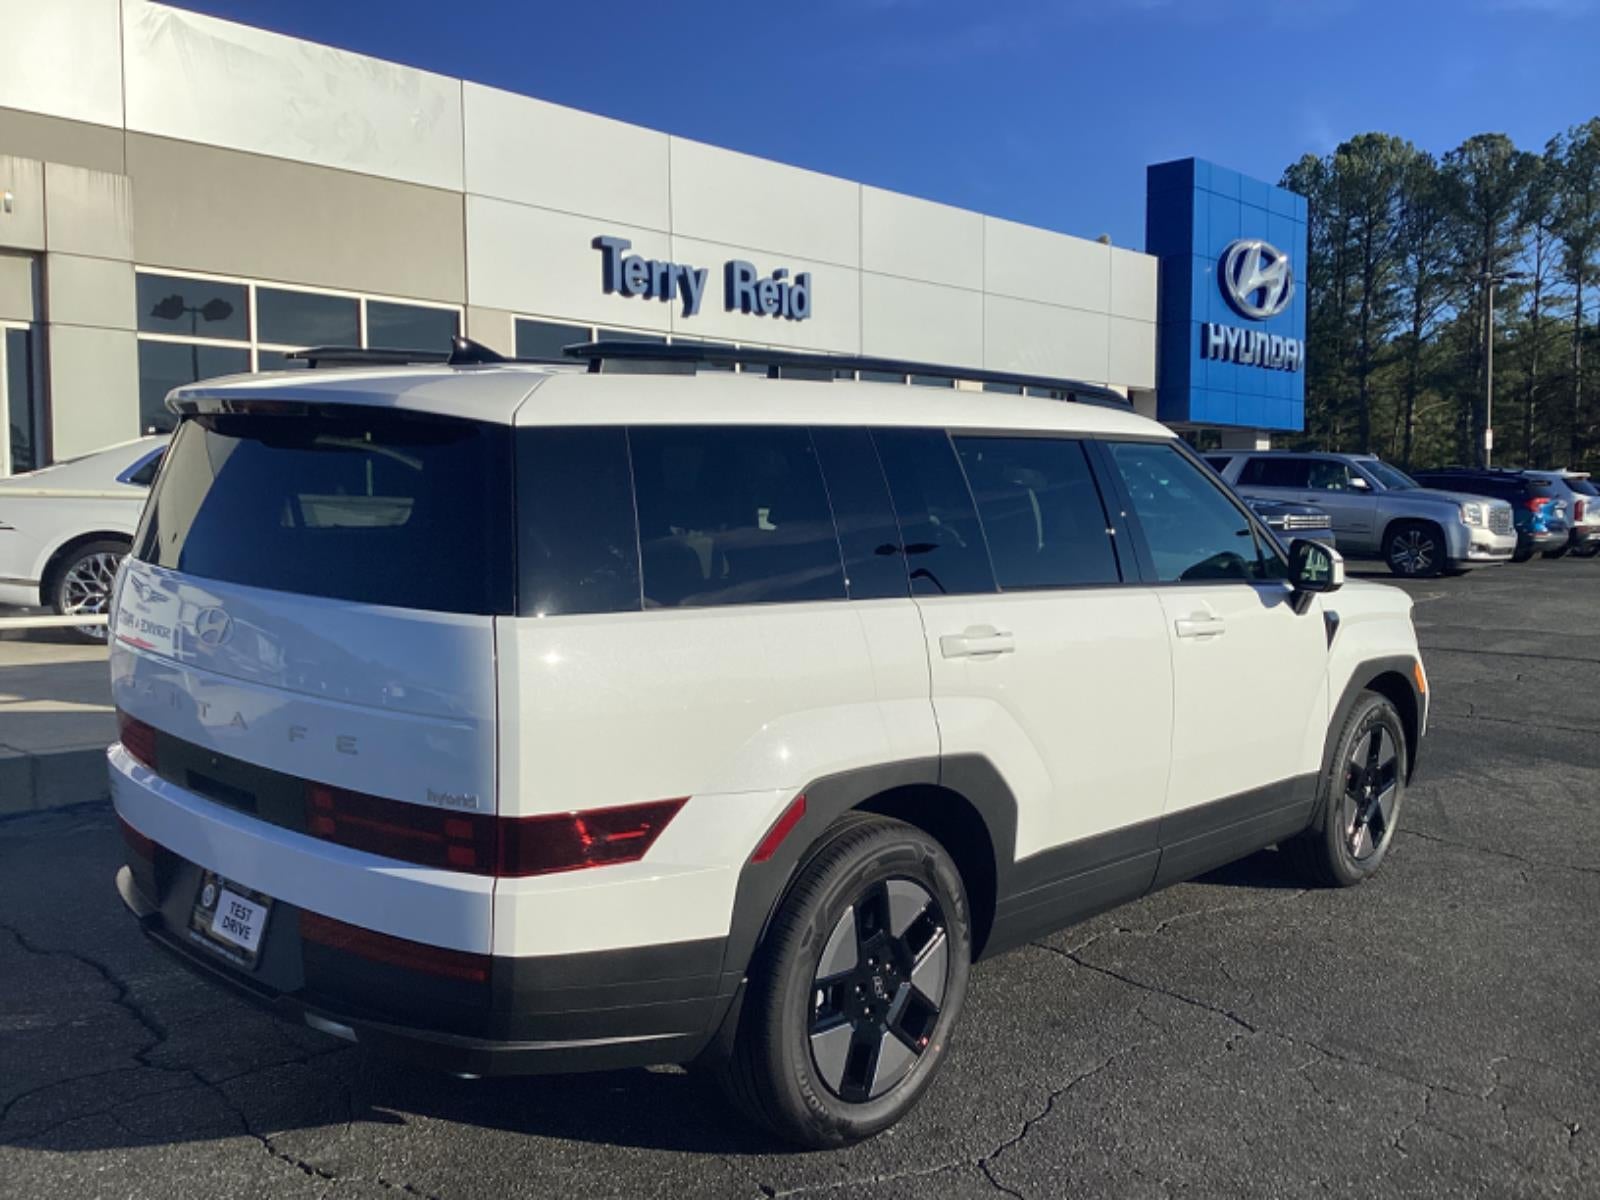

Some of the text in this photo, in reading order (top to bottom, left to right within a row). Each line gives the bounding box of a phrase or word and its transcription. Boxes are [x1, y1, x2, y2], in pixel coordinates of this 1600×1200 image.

[591, 235, 811, 321] Terry Reid
[1201, 322, 1304, 373] HYUNDAI
[288, 725, 359, 756] FE
[229, 901, 253, 922] TEST
[221, 915, 252, 940] DRIVE
